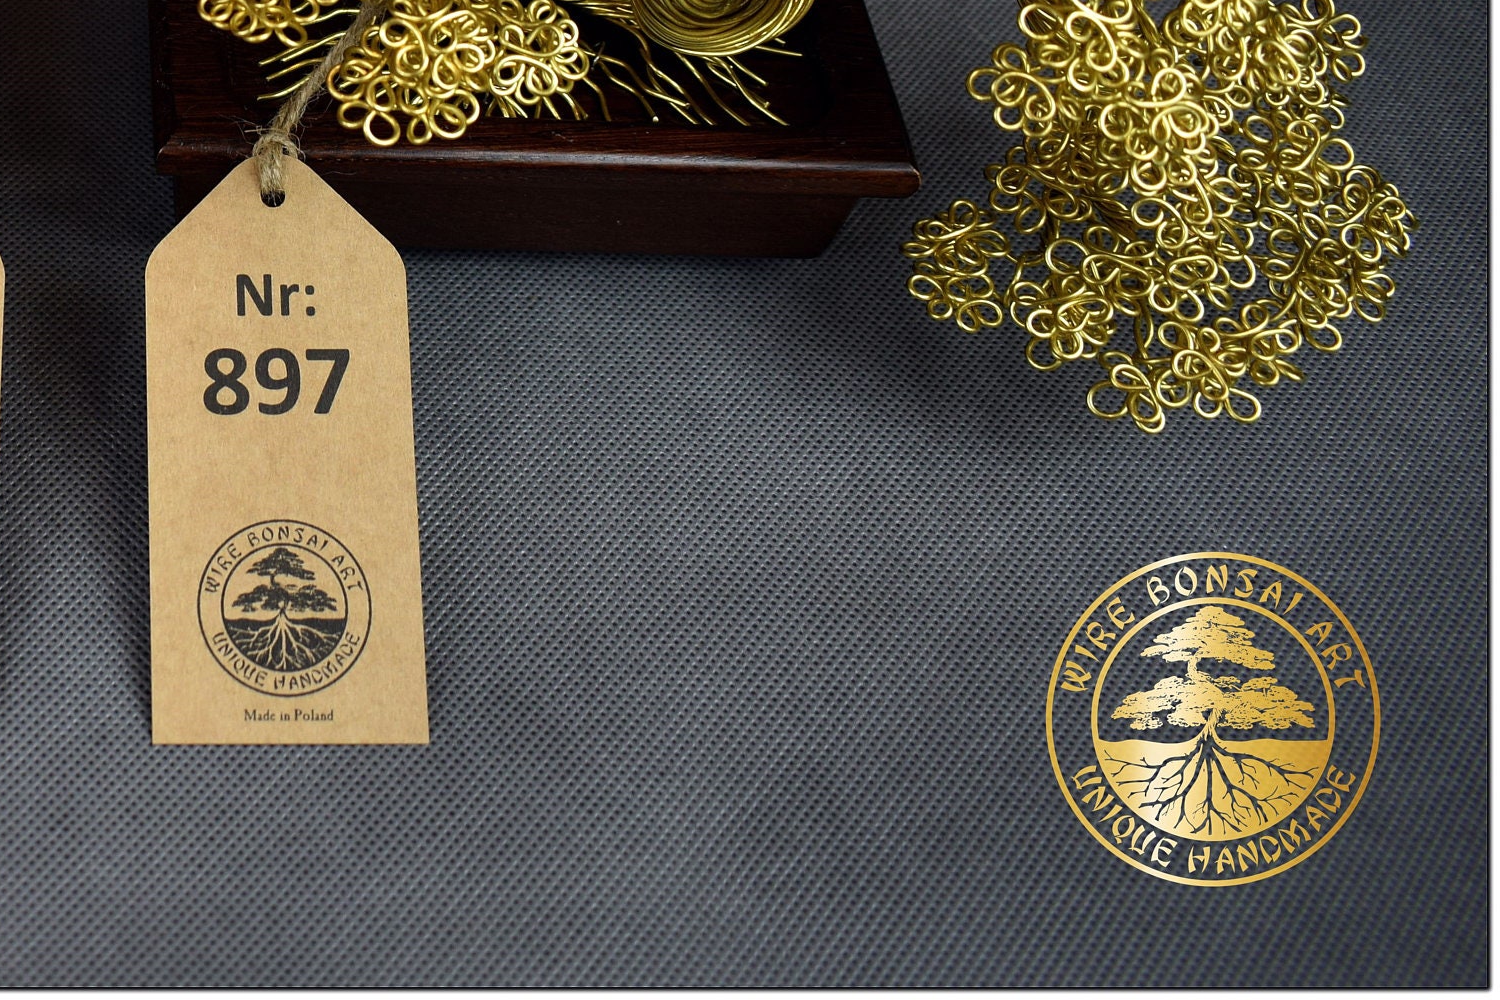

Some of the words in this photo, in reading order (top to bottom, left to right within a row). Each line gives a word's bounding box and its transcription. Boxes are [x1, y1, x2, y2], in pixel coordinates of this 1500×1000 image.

[235, 273, 317, 317] Nr:
[202, 348, 352, 416] 897
[205, 543, 242, 594] WIRE
[247, 525, 329, 551] BONSAI
[331, 555, 364, 592] ART
[211, 631, 269, 687] UNIQUE
[273, 632, 360, 690] HANDMADE
[244, 709, 276, 721] Made
[279, 709, 291, 721] in
[294, 709, 334, 721] Poland
